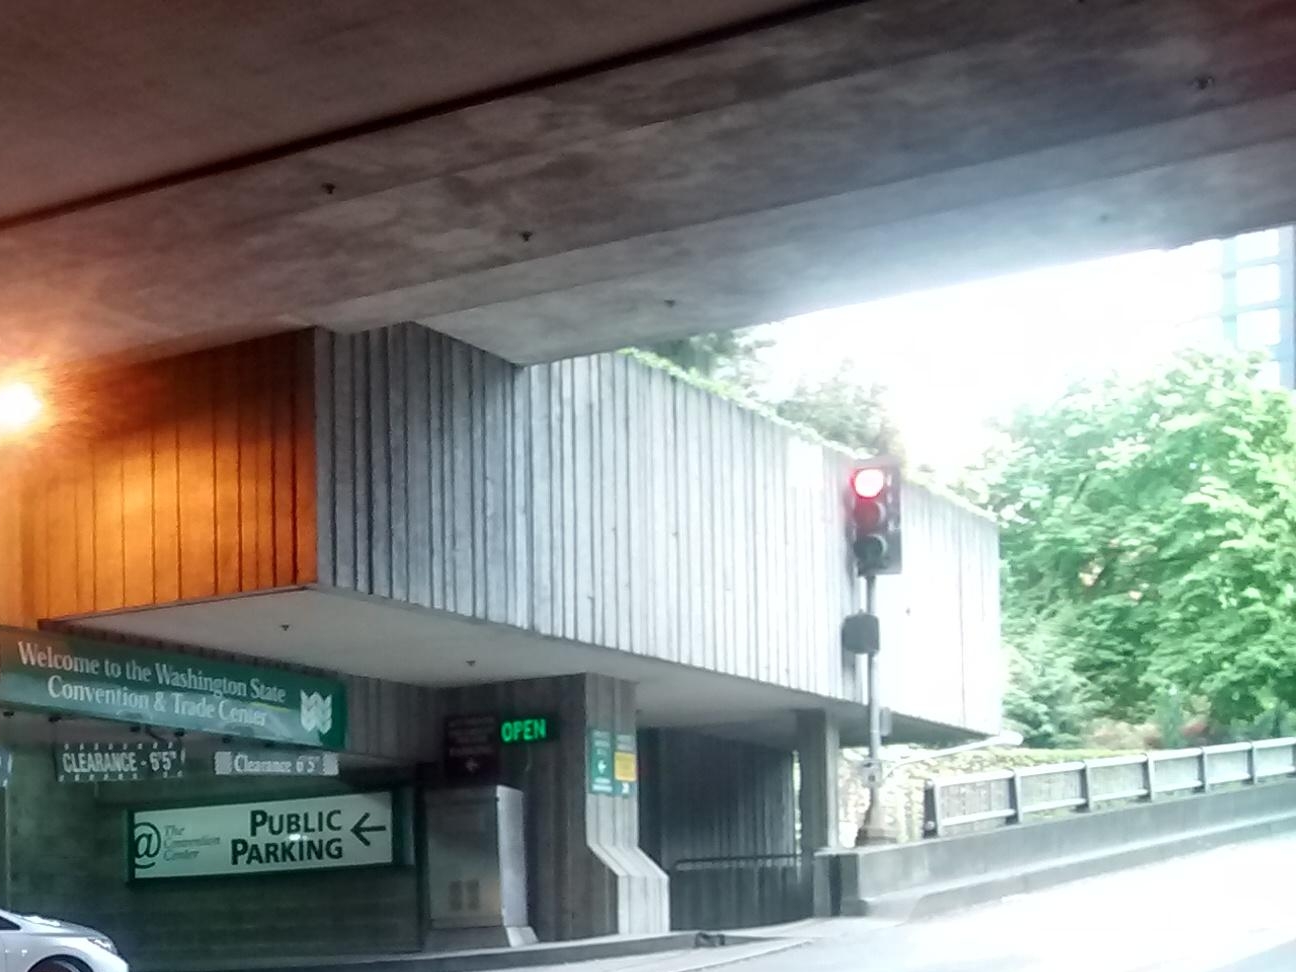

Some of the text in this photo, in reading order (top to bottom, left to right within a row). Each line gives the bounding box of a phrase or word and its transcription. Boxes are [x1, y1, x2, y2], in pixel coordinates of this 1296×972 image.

[18, 640, 286, 704] Welcome to the Washington State
[47, 675, 268, 727] Convention & Trade Center
[500, 717, 547, 743] OPEN
[62, 751, 138, 774] CLEARANCE
[234, 753, 292, 773] Clearance
[164, 824, 185, 837] The
